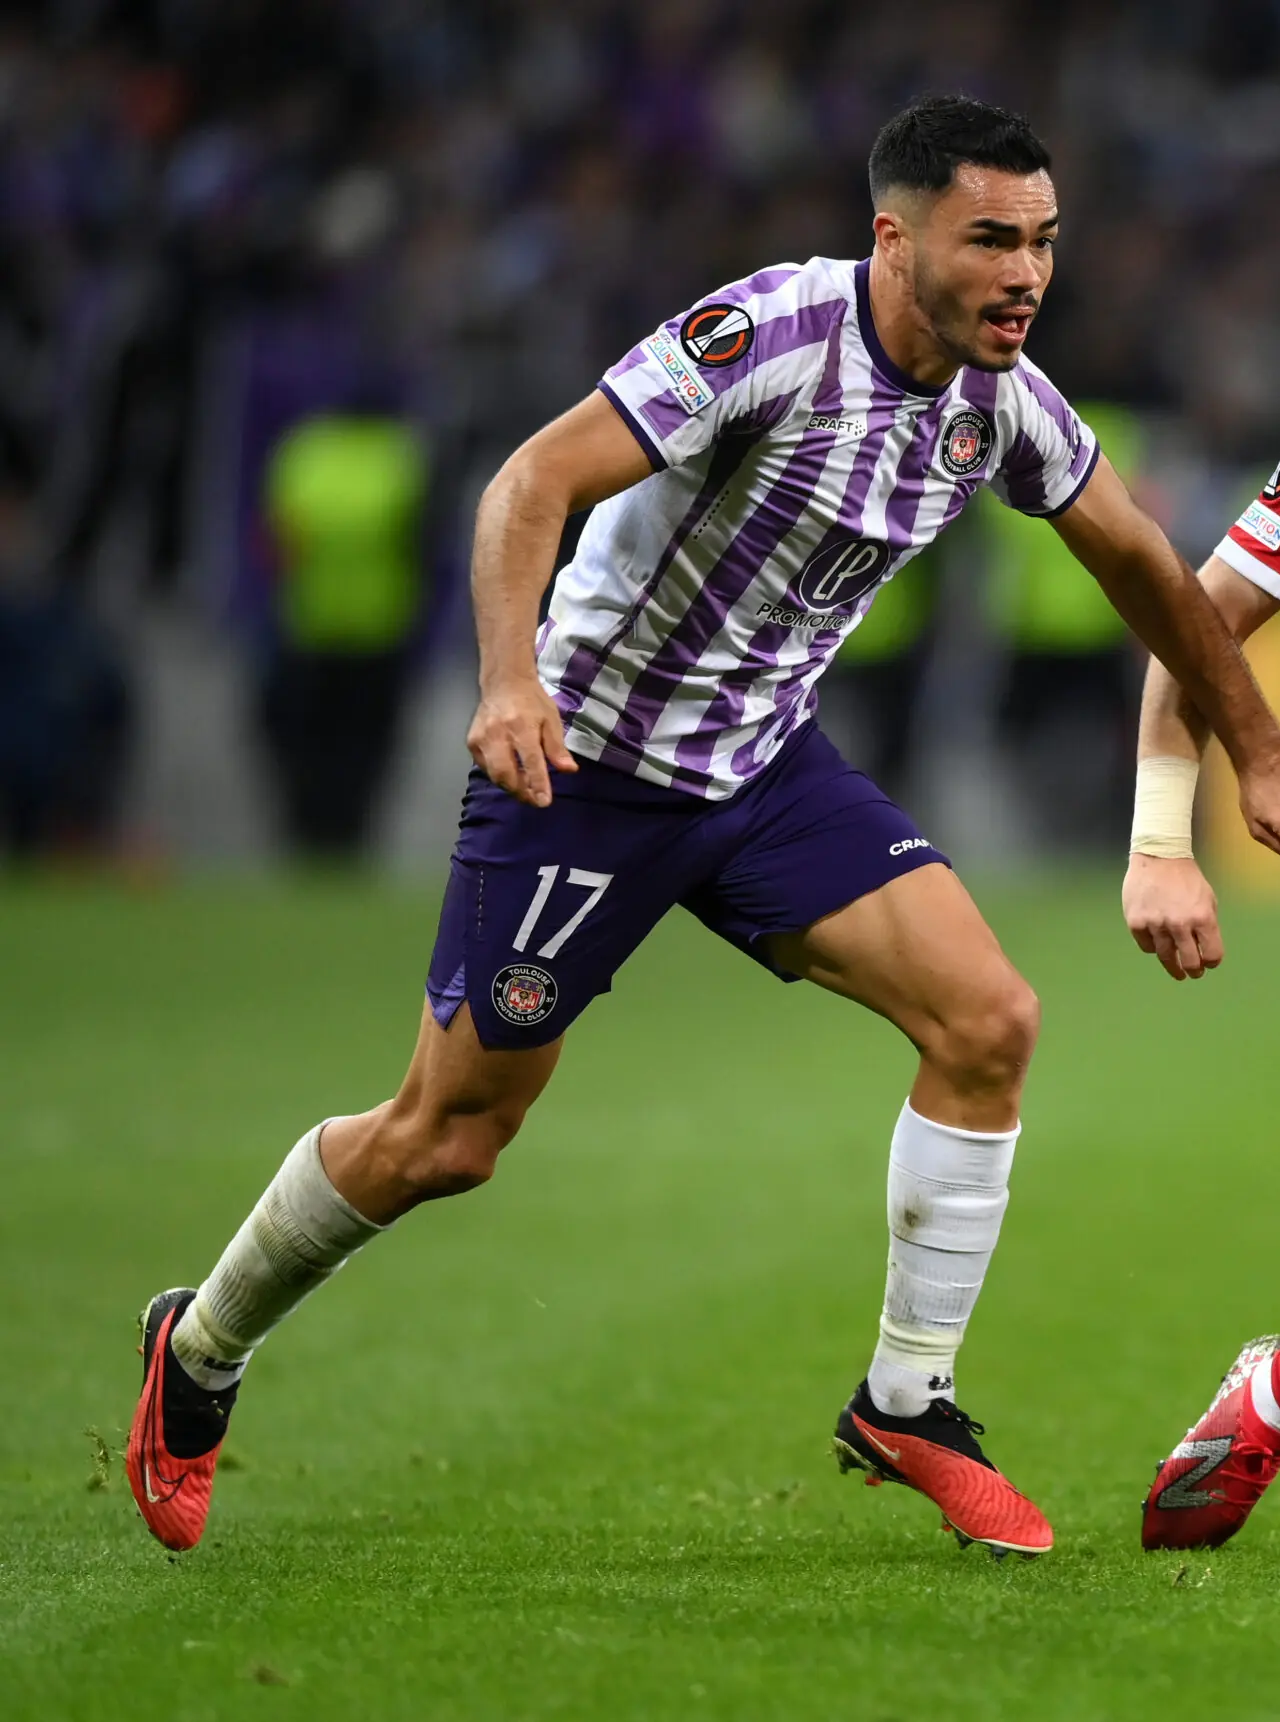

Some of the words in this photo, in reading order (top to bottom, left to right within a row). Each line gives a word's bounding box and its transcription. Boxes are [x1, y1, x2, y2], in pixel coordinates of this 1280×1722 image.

[651, 336, 705, 407] FOUNDATION
[808, 417, 854, 432] CRAFT
[952, 414, 985, 430] TOULOUSE
[944, 454, 966, 473] FOOTBALL
[966, 456, 982, 471] CLUB
[812, 542, 879, 601] LP
[512, 864, 614, 960] 17
[508, 968, 551, 986] TOULOUSE
[496, 997, 526, 1021] FOOTBALL
[526, 1009, 546, 1021] CLUB
